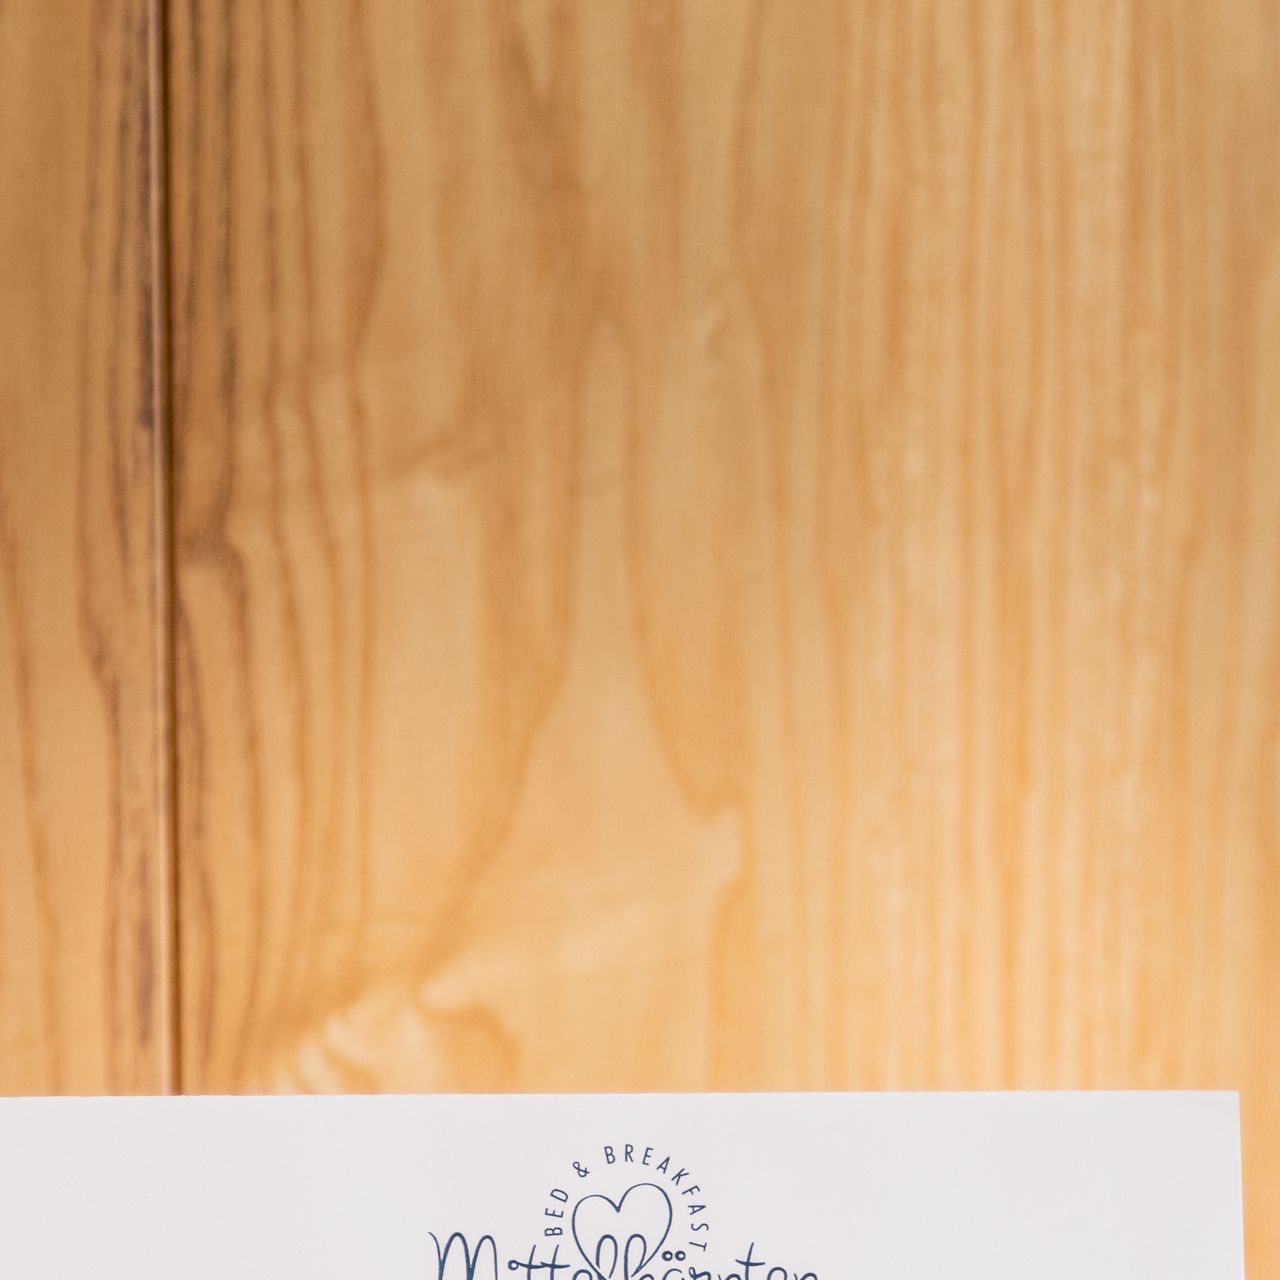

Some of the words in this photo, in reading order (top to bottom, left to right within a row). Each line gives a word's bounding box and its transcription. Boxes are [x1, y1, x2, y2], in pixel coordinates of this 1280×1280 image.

[544, 1188, 569, 1237] BED
[572, 1161, 590, 1178] &
[604, 1144, 709, 1252] BREAKFAST
